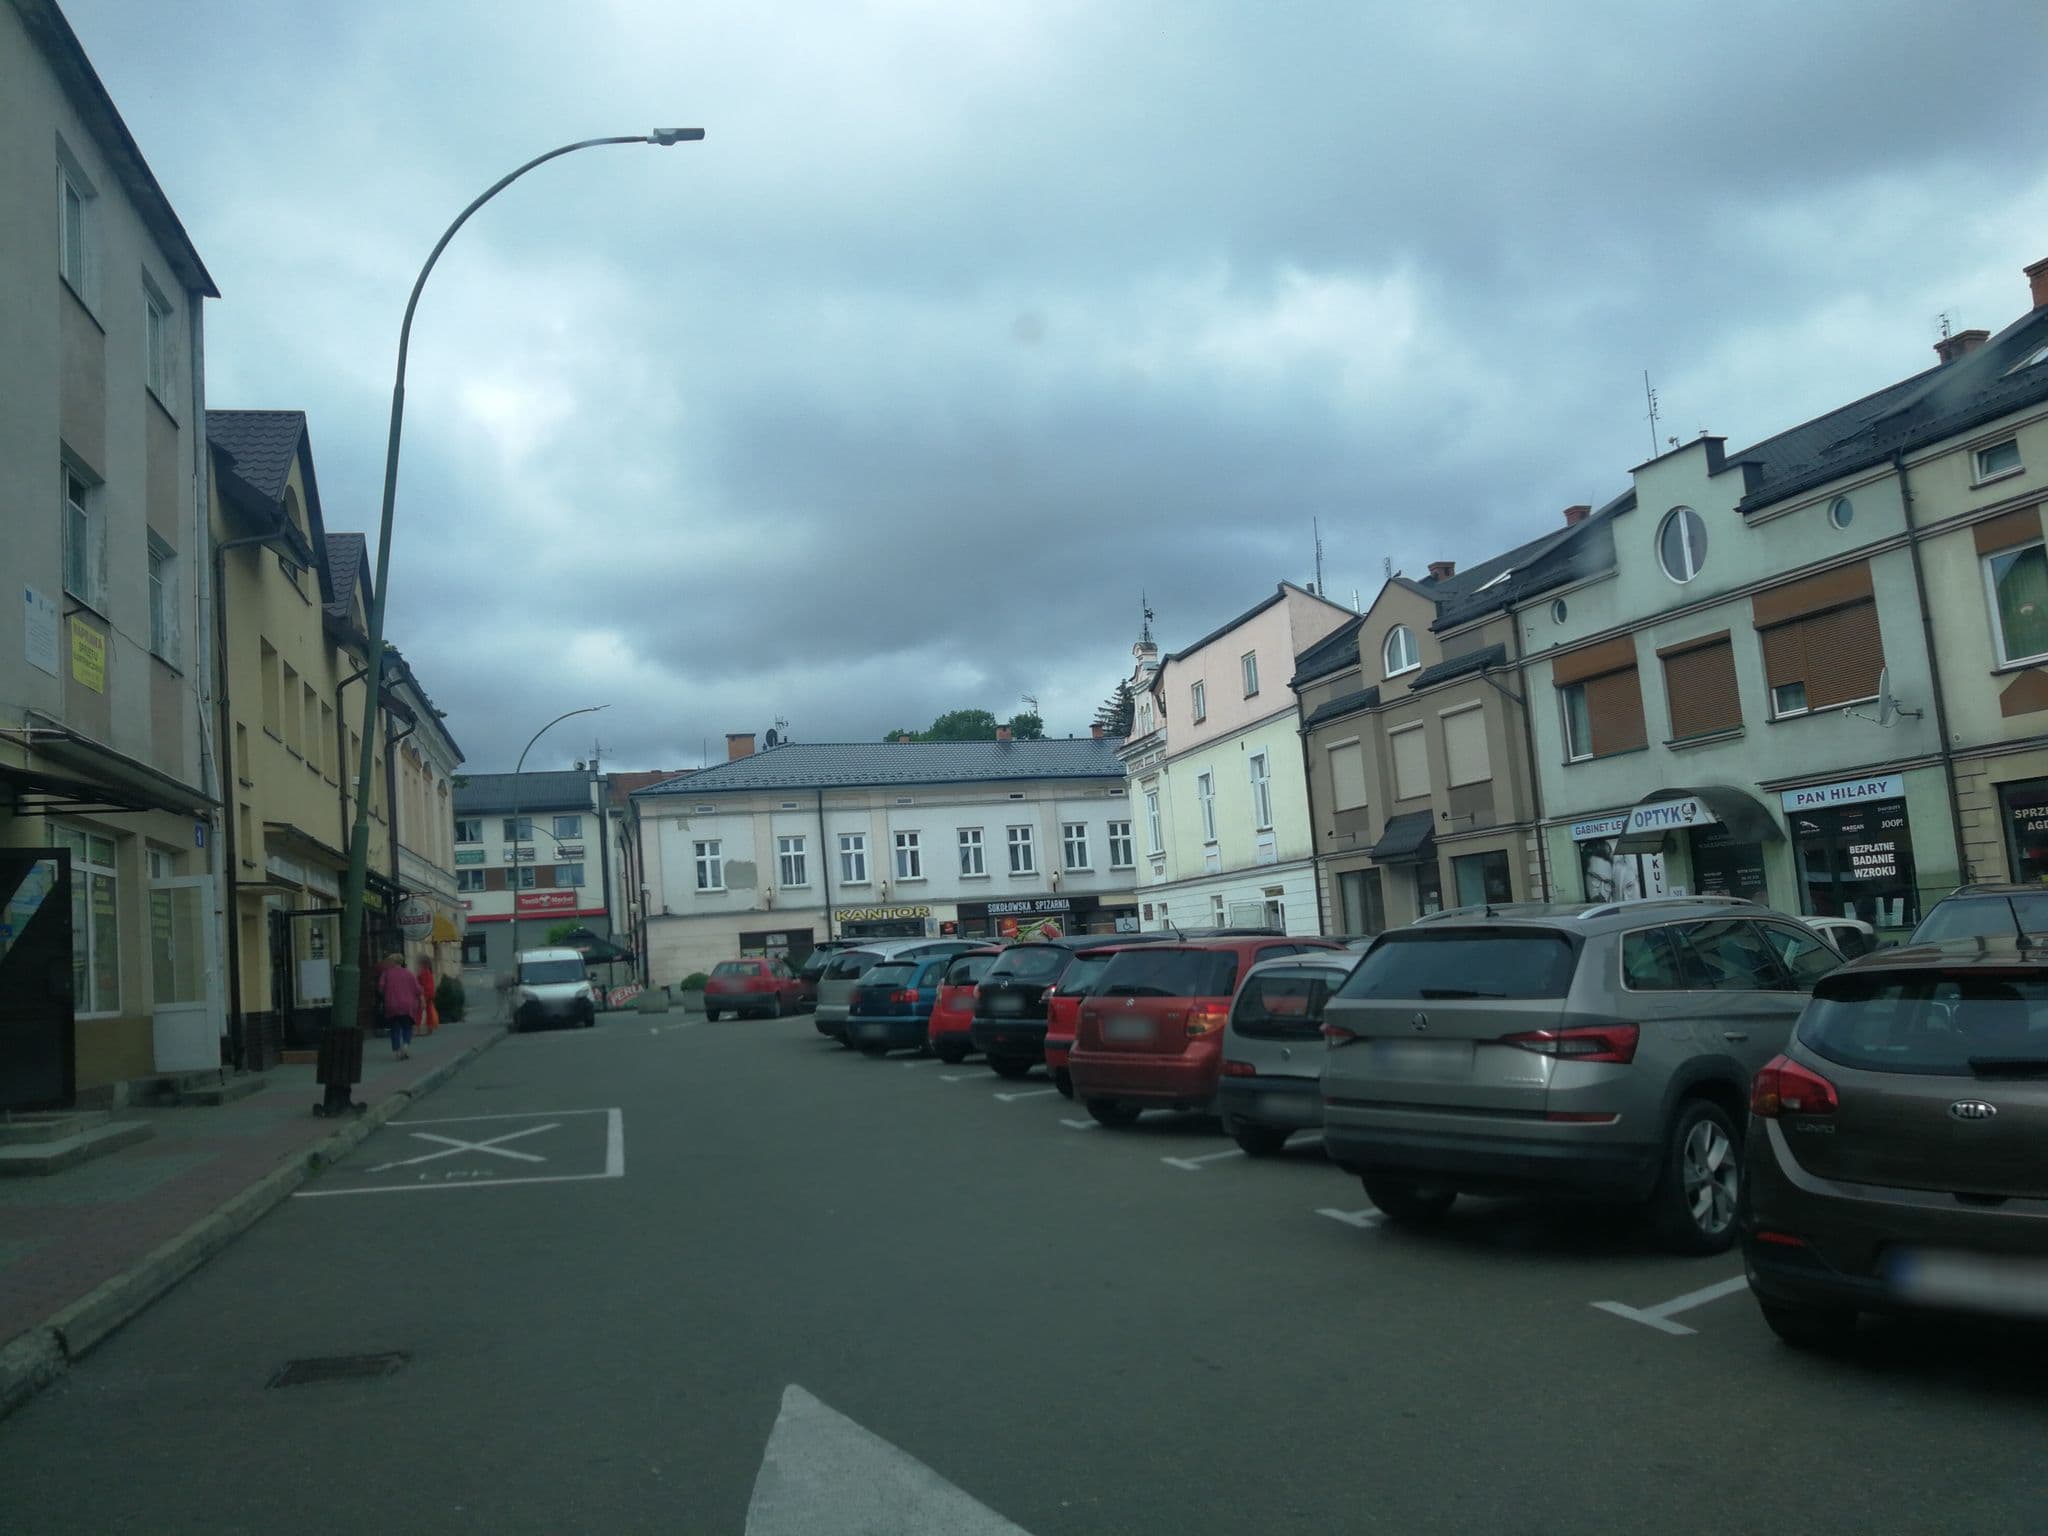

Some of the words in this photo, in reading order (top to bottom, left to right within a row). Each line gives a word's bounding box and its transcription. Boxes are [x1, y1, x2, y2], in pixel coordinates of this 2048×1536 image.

[1797, 790, 1826, 805] PAN
[1830, 781, 1888, 800] HILARY
[1634, 806, 1682, 828] OPTYK
[1881, 818, 1904, 829] JOOP!
[1575, 820, 1609, 836] GABINET
[1852, 853, 1895, 866] BADANIE
[1854, 866, 1896, 878] WZROKU
[834, 905, 931, 922] KANTOR
[1957, 1103, 1989, 1117] KIA
